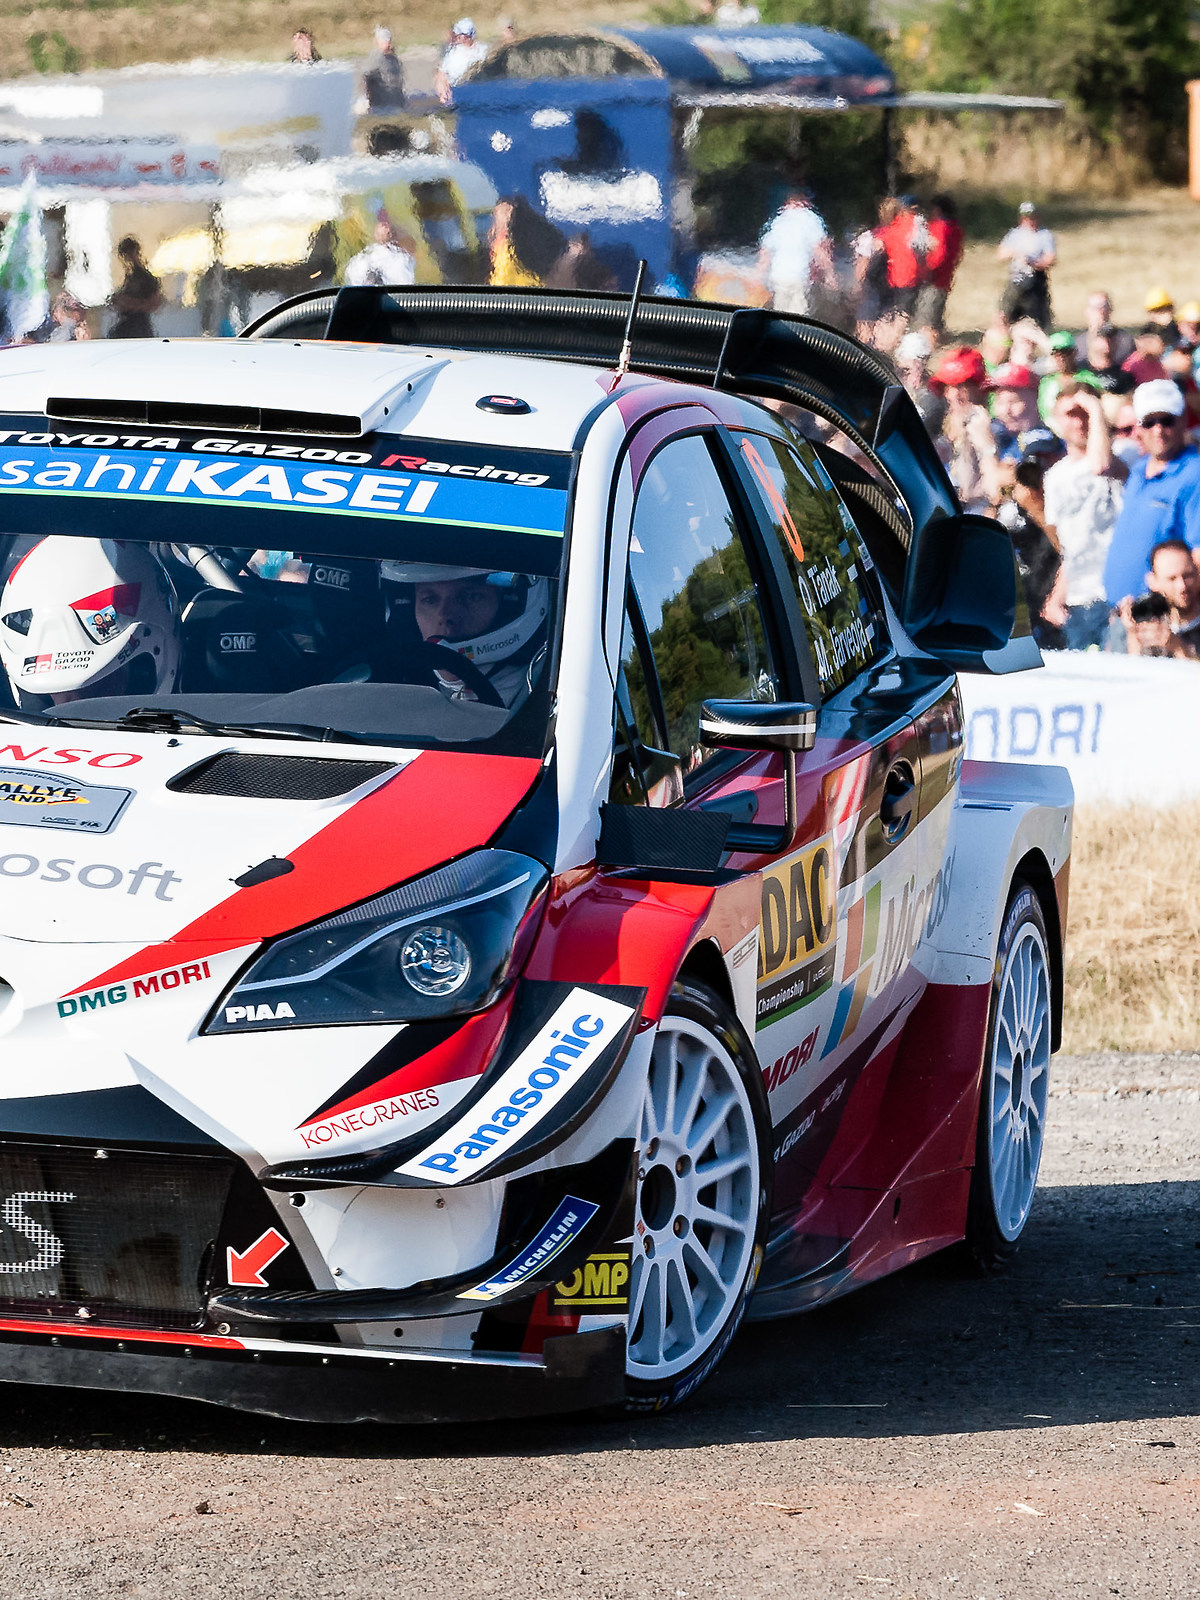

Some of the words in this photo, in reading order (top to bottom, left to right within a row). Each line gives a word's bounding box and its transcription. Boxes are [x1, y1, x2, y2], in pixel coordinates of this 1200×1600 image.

[191, 438, 372, 465] GAZOO
[379, 453, 551, 487] Racing
[316, 566, 351, 587] OMP
[55, 649, 95, 658] TOYOTA
[220, 635, 256, 651] OMP
[476, 632, 521, 656] Microsoft
[54, 656, 91, 665] GAZOO
[54, 662, 89, 671] Racing
[757, 847, 833, 980] DAC
[56, 985, 128, 1019] DMG
[132, 960, 211, 999] MORI
[756, 980, 804, 1016] Championship
[225, 1001, 297, 1024] PIAA
[417, 1013, 605, 1174] Panasonic
[299, 1088, 440, 1149] KONECRANES
[504, 1210, 579, 1282] MICHELIN
